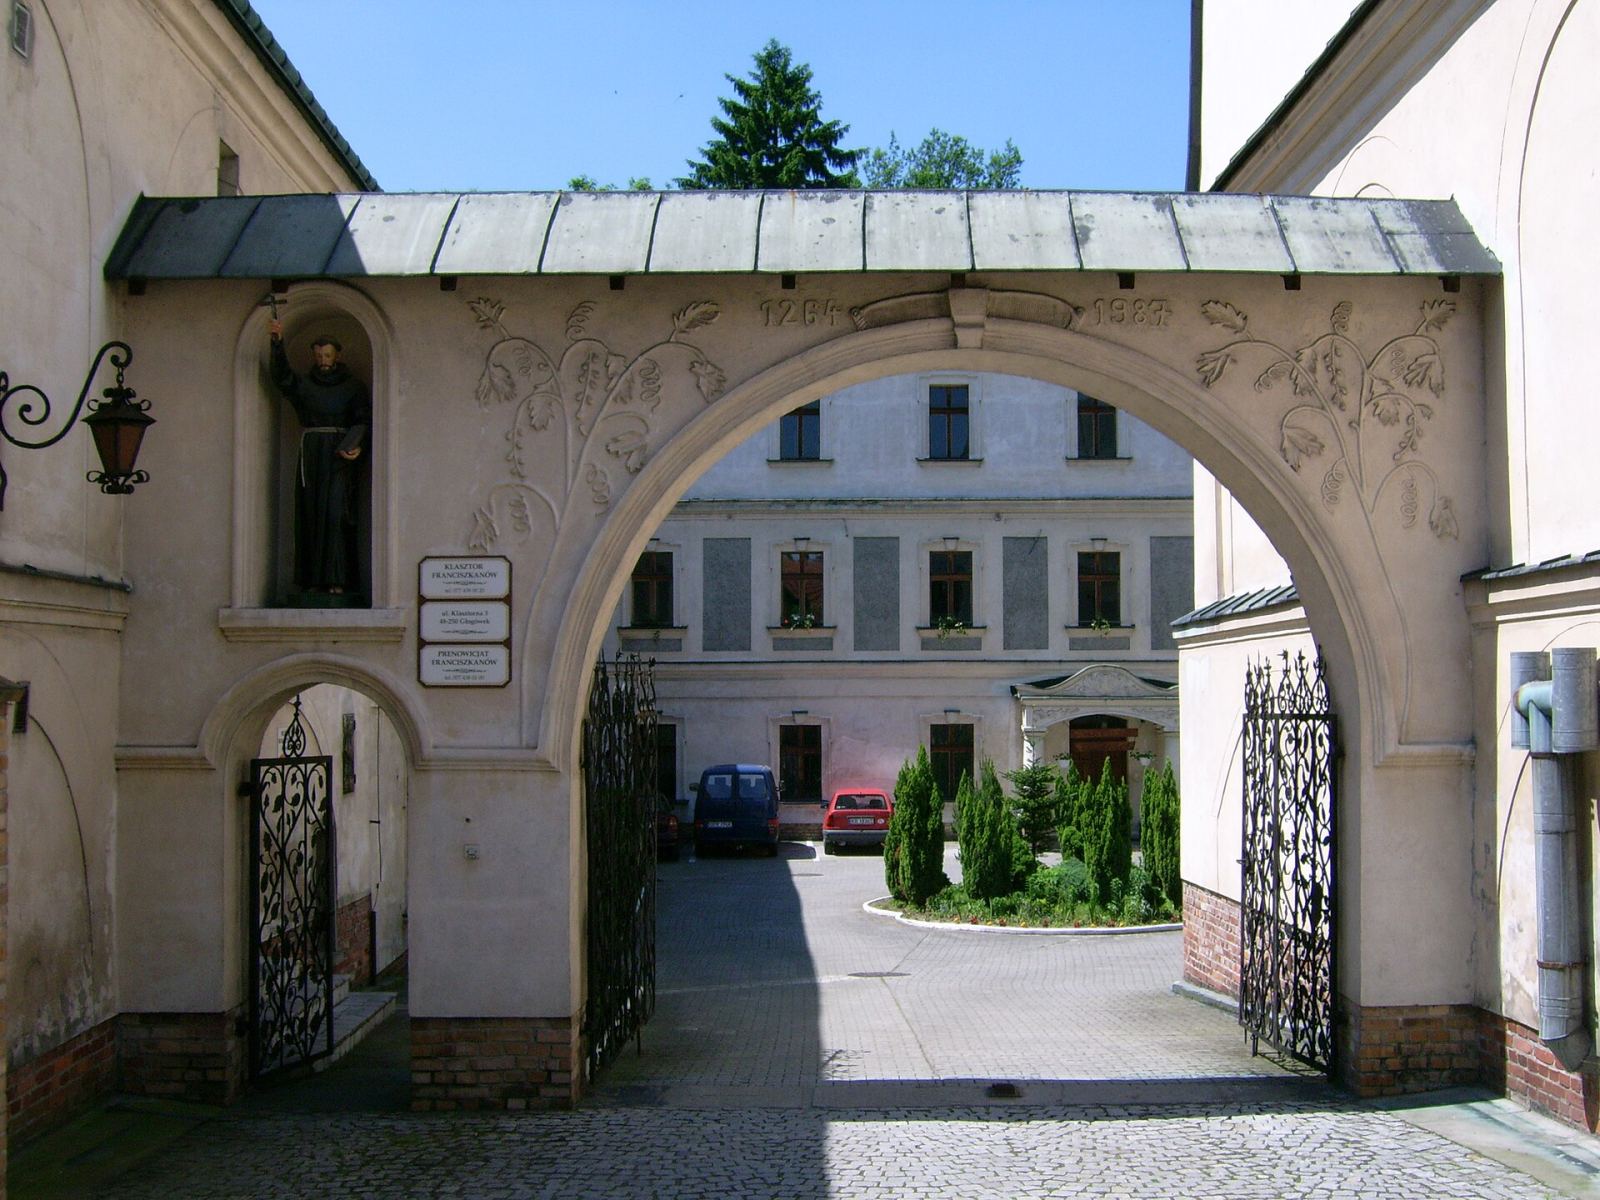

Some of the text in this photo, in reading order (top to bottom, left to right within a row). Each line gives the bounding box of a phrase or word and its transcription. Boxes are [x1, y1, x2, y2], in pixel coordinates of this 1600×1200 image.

[760, 298, 841, 328] 1264
[1093, 298, 1172, 327] 1987
[431, 571, 497, 579] FRANCISZKANÓW
[431, 658, 497, 666] FRANCISZKANÓW
